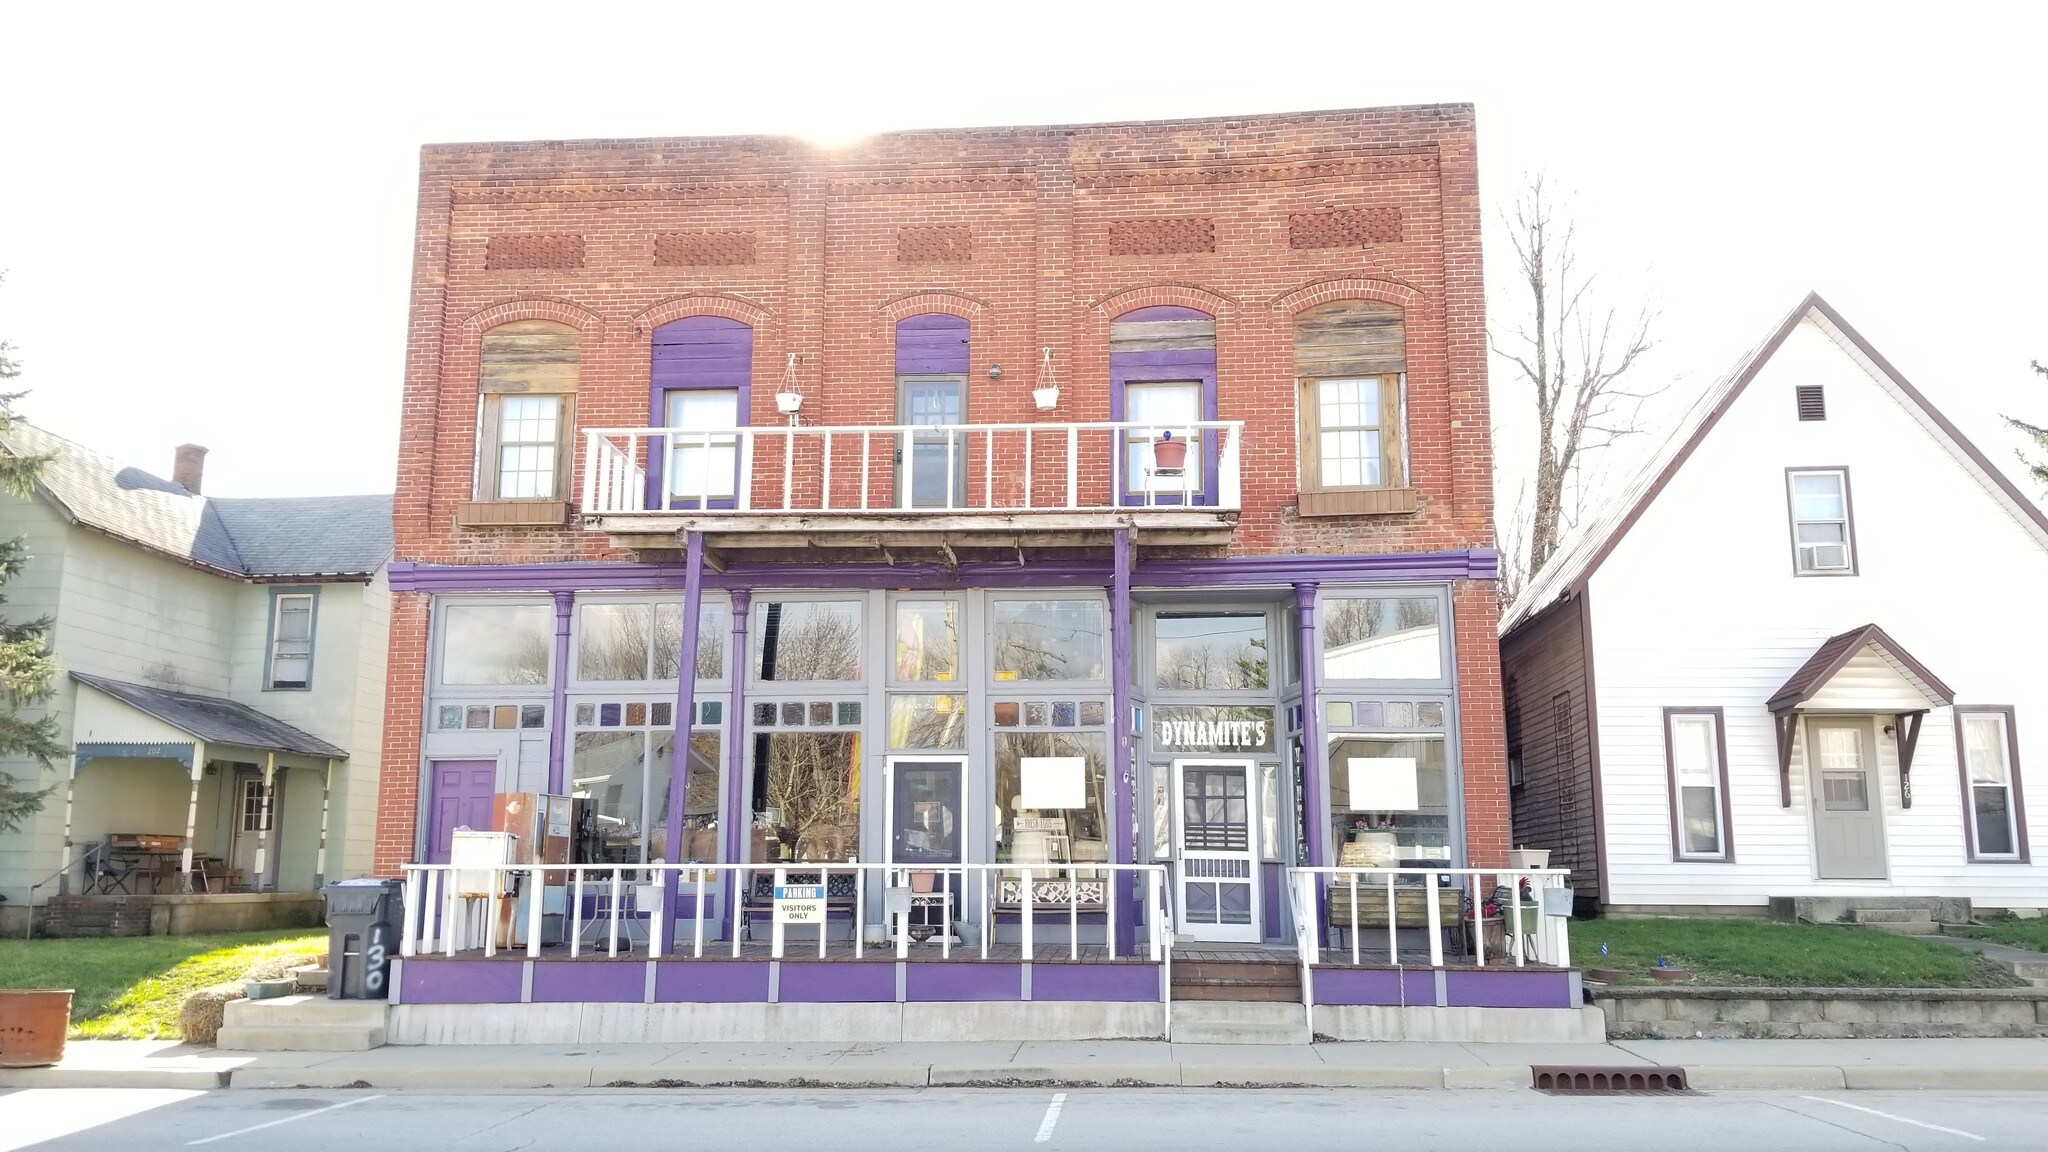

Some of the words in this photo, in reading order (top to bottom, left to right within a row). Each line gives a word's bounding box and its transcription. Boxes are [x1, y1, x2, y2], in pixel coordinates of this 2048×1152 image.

[1161, 720, 1267, 746] DYNAMITE'S
[782, 887, 817, 899] PARKING
[781, 904, 817, 912] VISITORS
[788, 912, 808, 920] ONLY
[366, 927, 385, 990] 130
